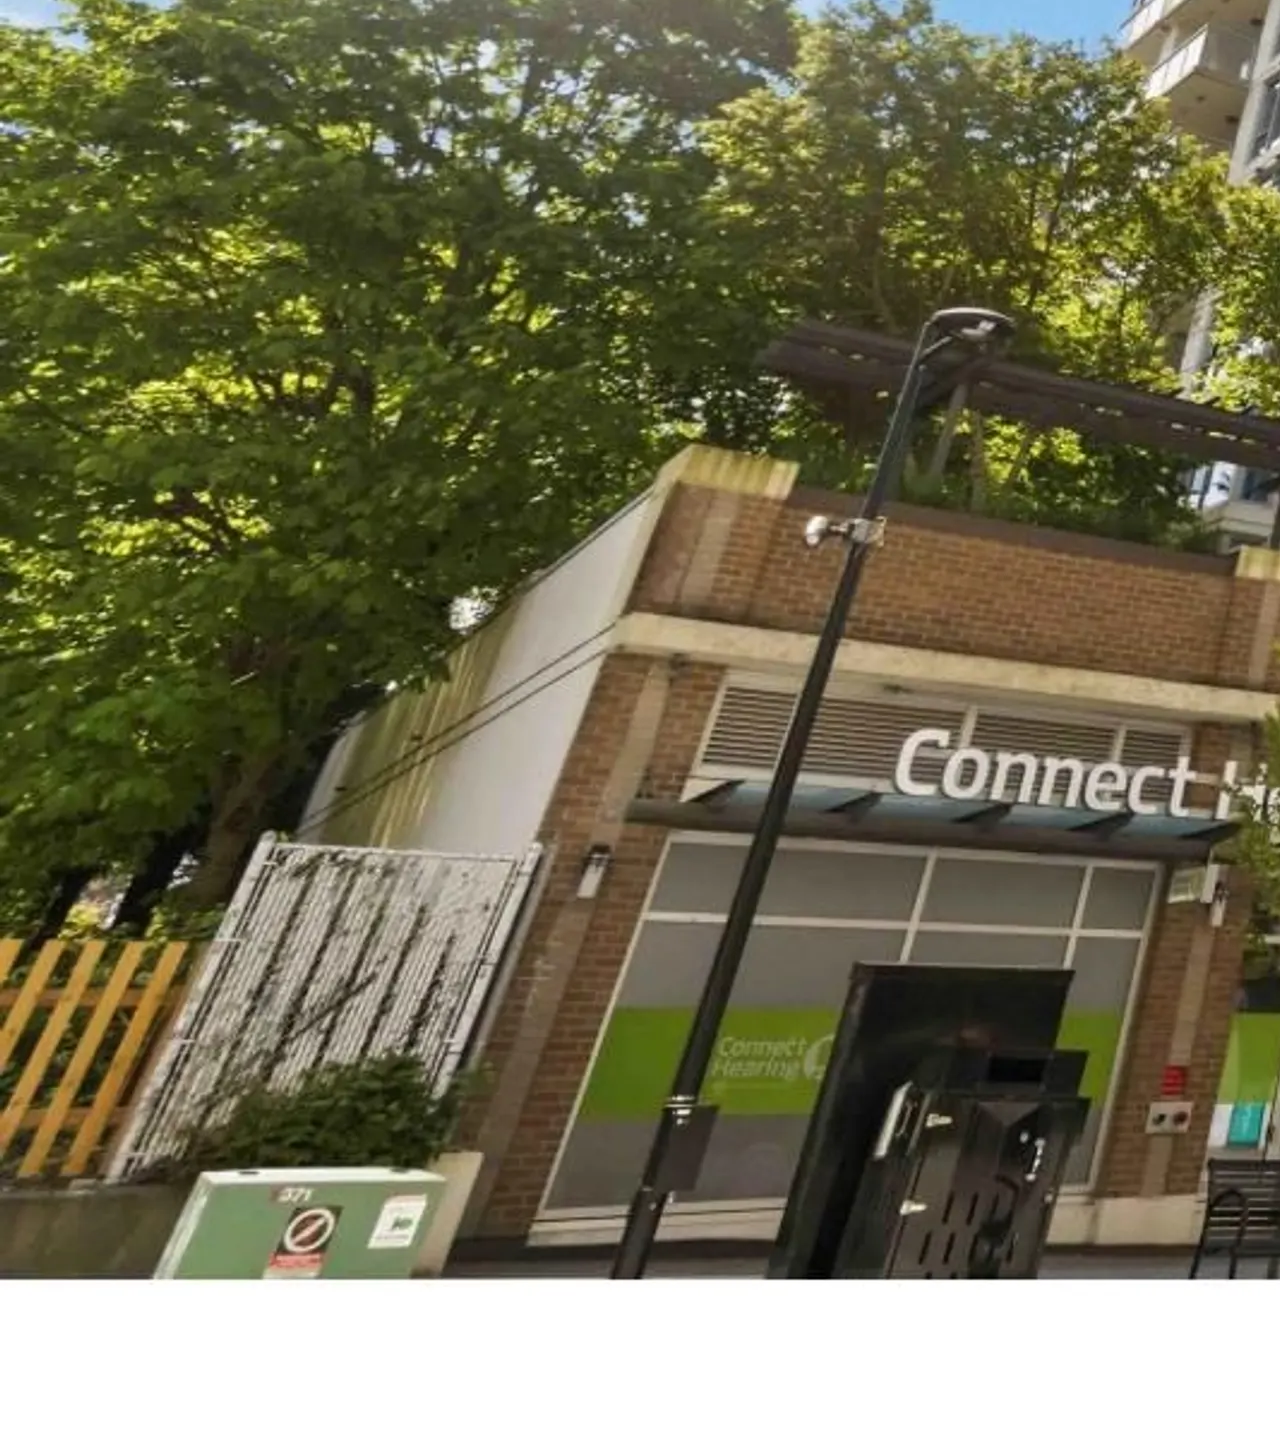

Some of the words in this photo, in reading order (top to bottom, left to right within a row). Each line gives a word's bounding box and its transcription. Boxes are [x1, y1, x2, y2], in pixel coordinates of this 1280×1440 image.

[894, 728, 1196, 817] Connect
[719, 1036, 808, 1057] Connect
[711, 1058, 801, 1082] Hearing
